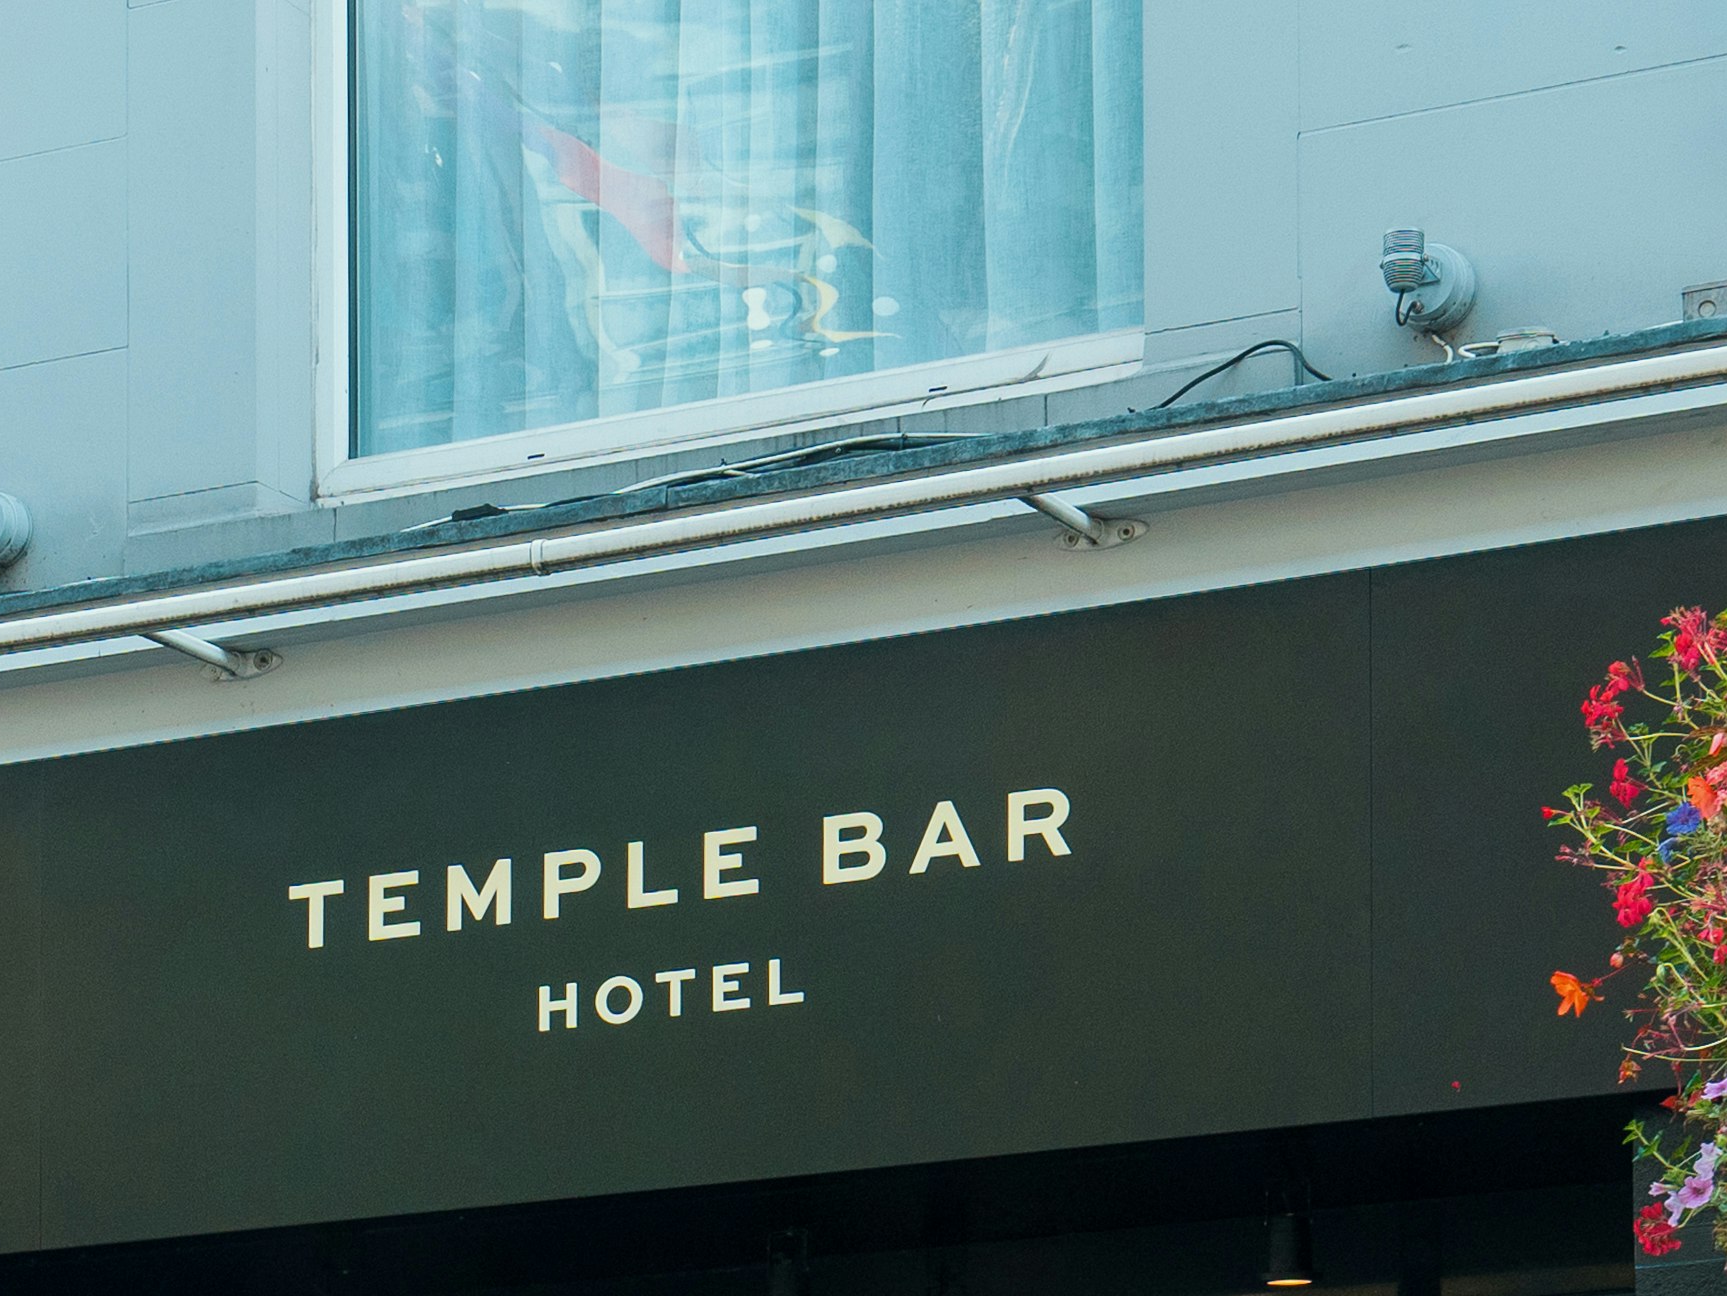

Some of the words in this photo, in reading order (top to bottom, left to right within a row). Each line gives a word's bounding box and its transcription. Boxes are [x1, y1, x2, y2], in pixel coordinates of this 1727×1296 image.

[287, 825, 761, 949] TEMPLE
[822, 787, 1073, 885] BAR
[537, 957, 806, 1032] HOTEL
